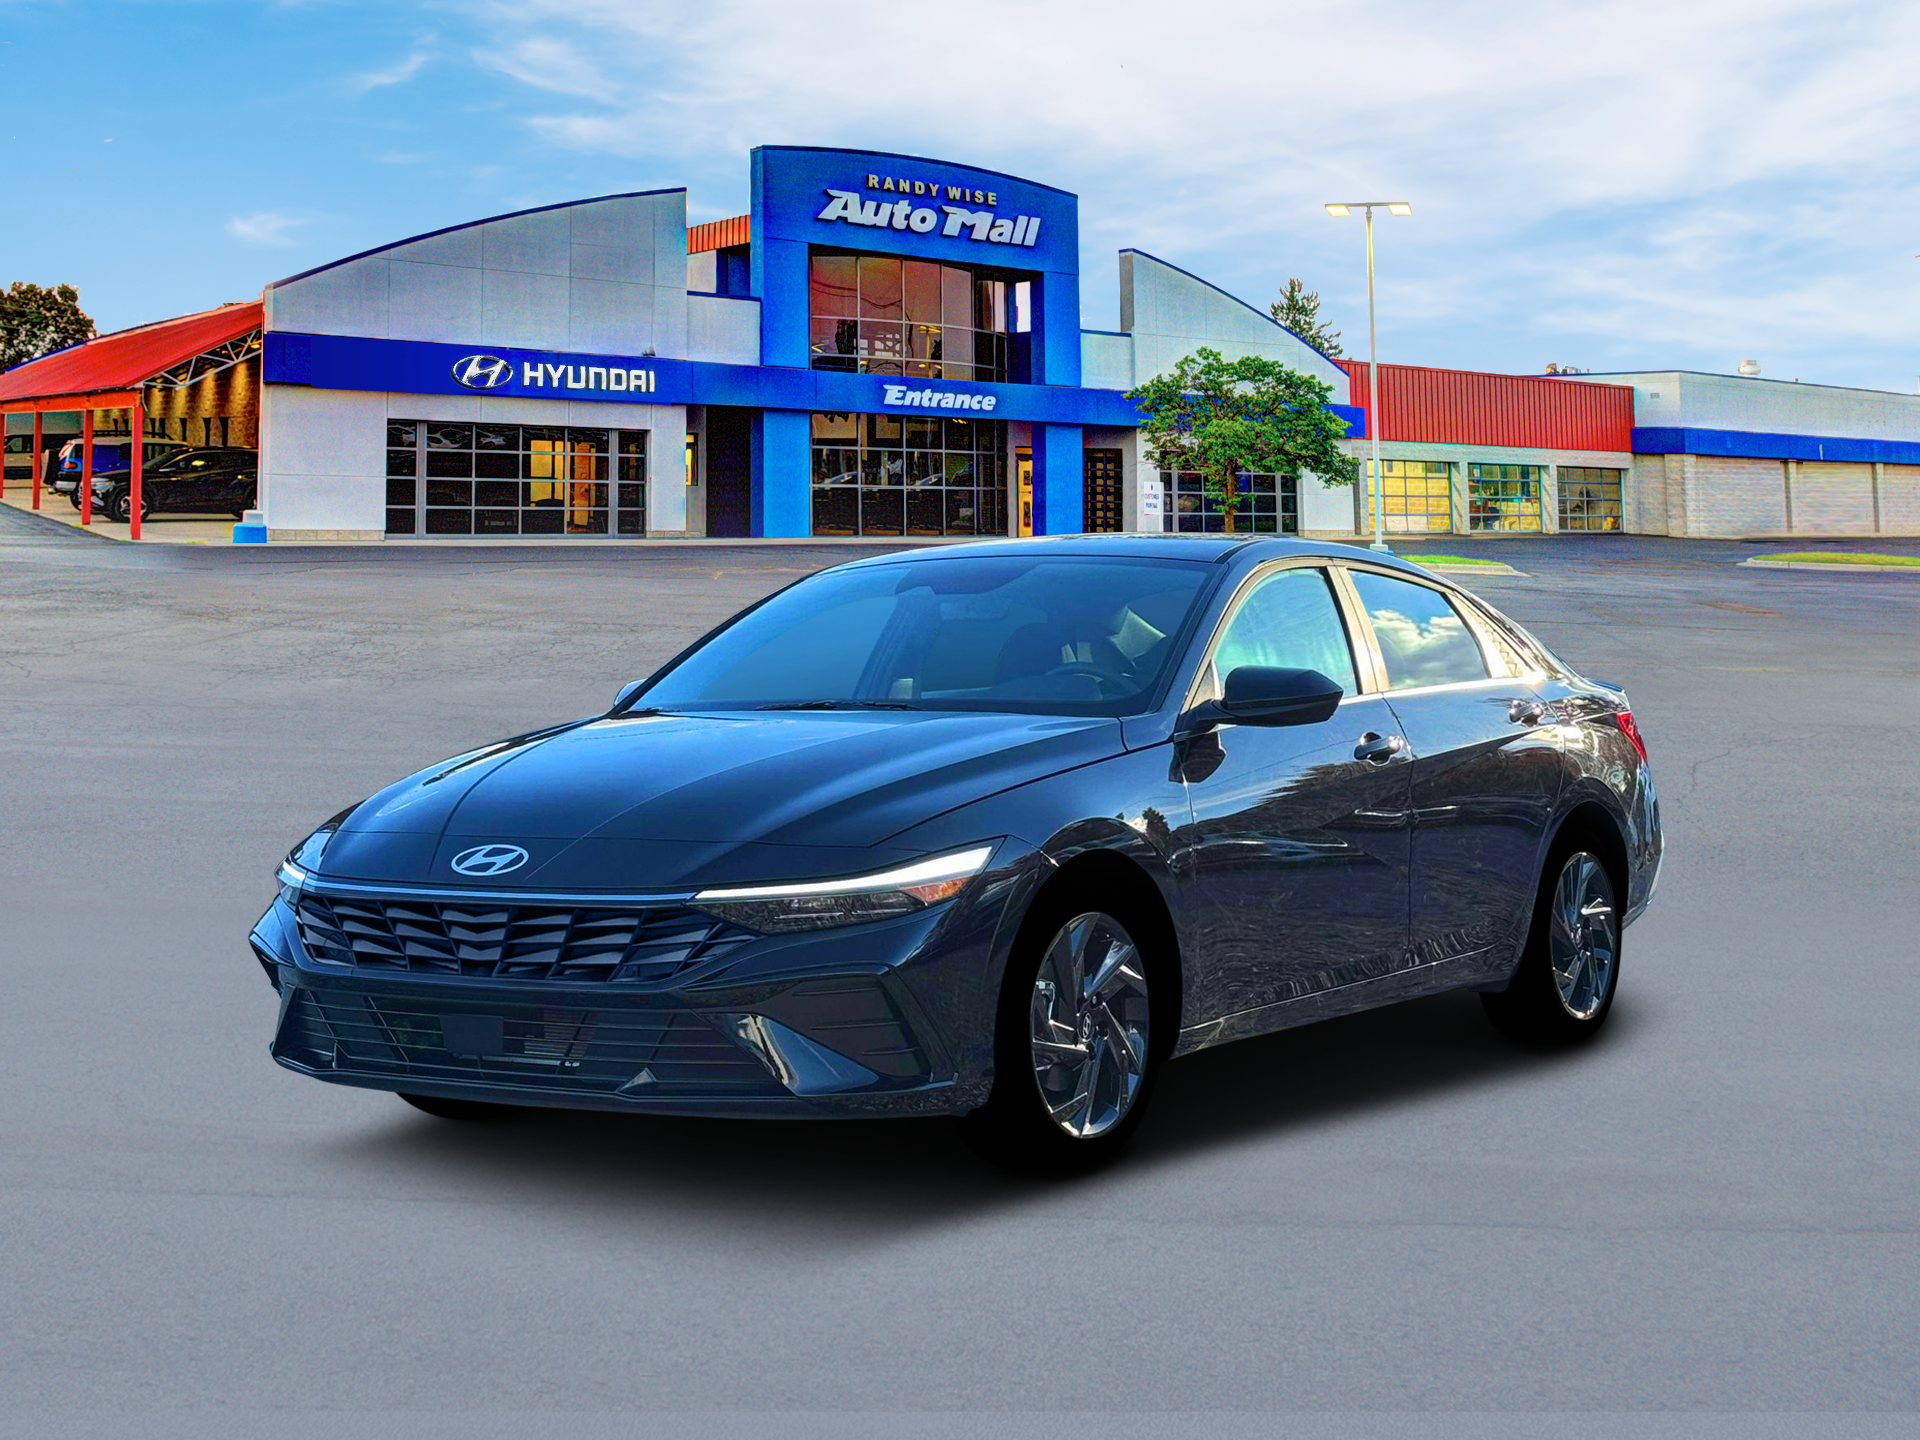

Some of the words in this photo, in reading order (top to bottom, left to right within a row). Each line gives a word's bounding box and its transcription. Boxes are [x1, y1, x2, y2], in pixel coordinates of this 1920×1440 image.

[867, 174, 940, 197] RANDY
[947, 186, 998, 206] WISE
[815, 189, 938, 233] Auto
[941, 205, 1041, 247] Mall
[522, 361, 656, 393] HYUNDAI
[883, 384, 997, 411] Entrance
